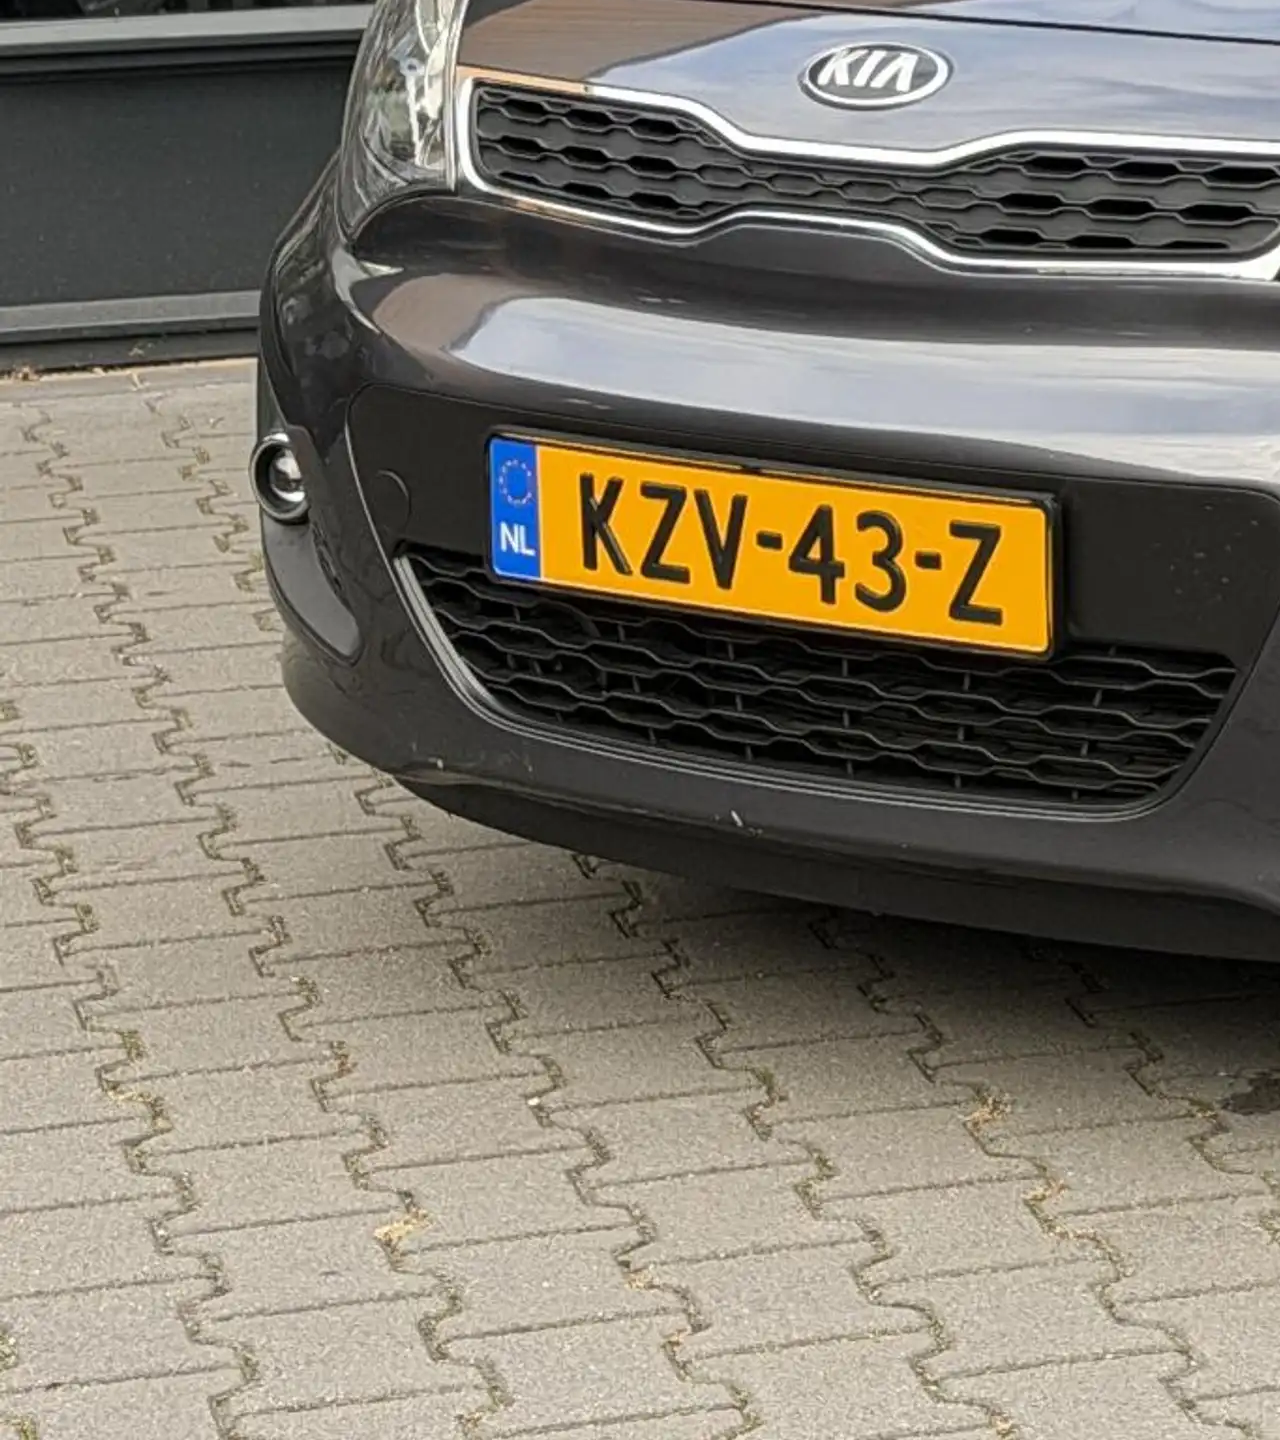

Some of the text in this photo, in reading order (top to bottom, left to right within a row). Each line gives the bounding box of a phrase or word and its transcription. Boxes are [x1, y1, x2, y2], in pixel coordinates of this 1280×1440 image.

[817, 48, 919, 93] KIA
[499, 521, 536, 557] NL
[578, 472, 1003, 628] KZV-43-Z
